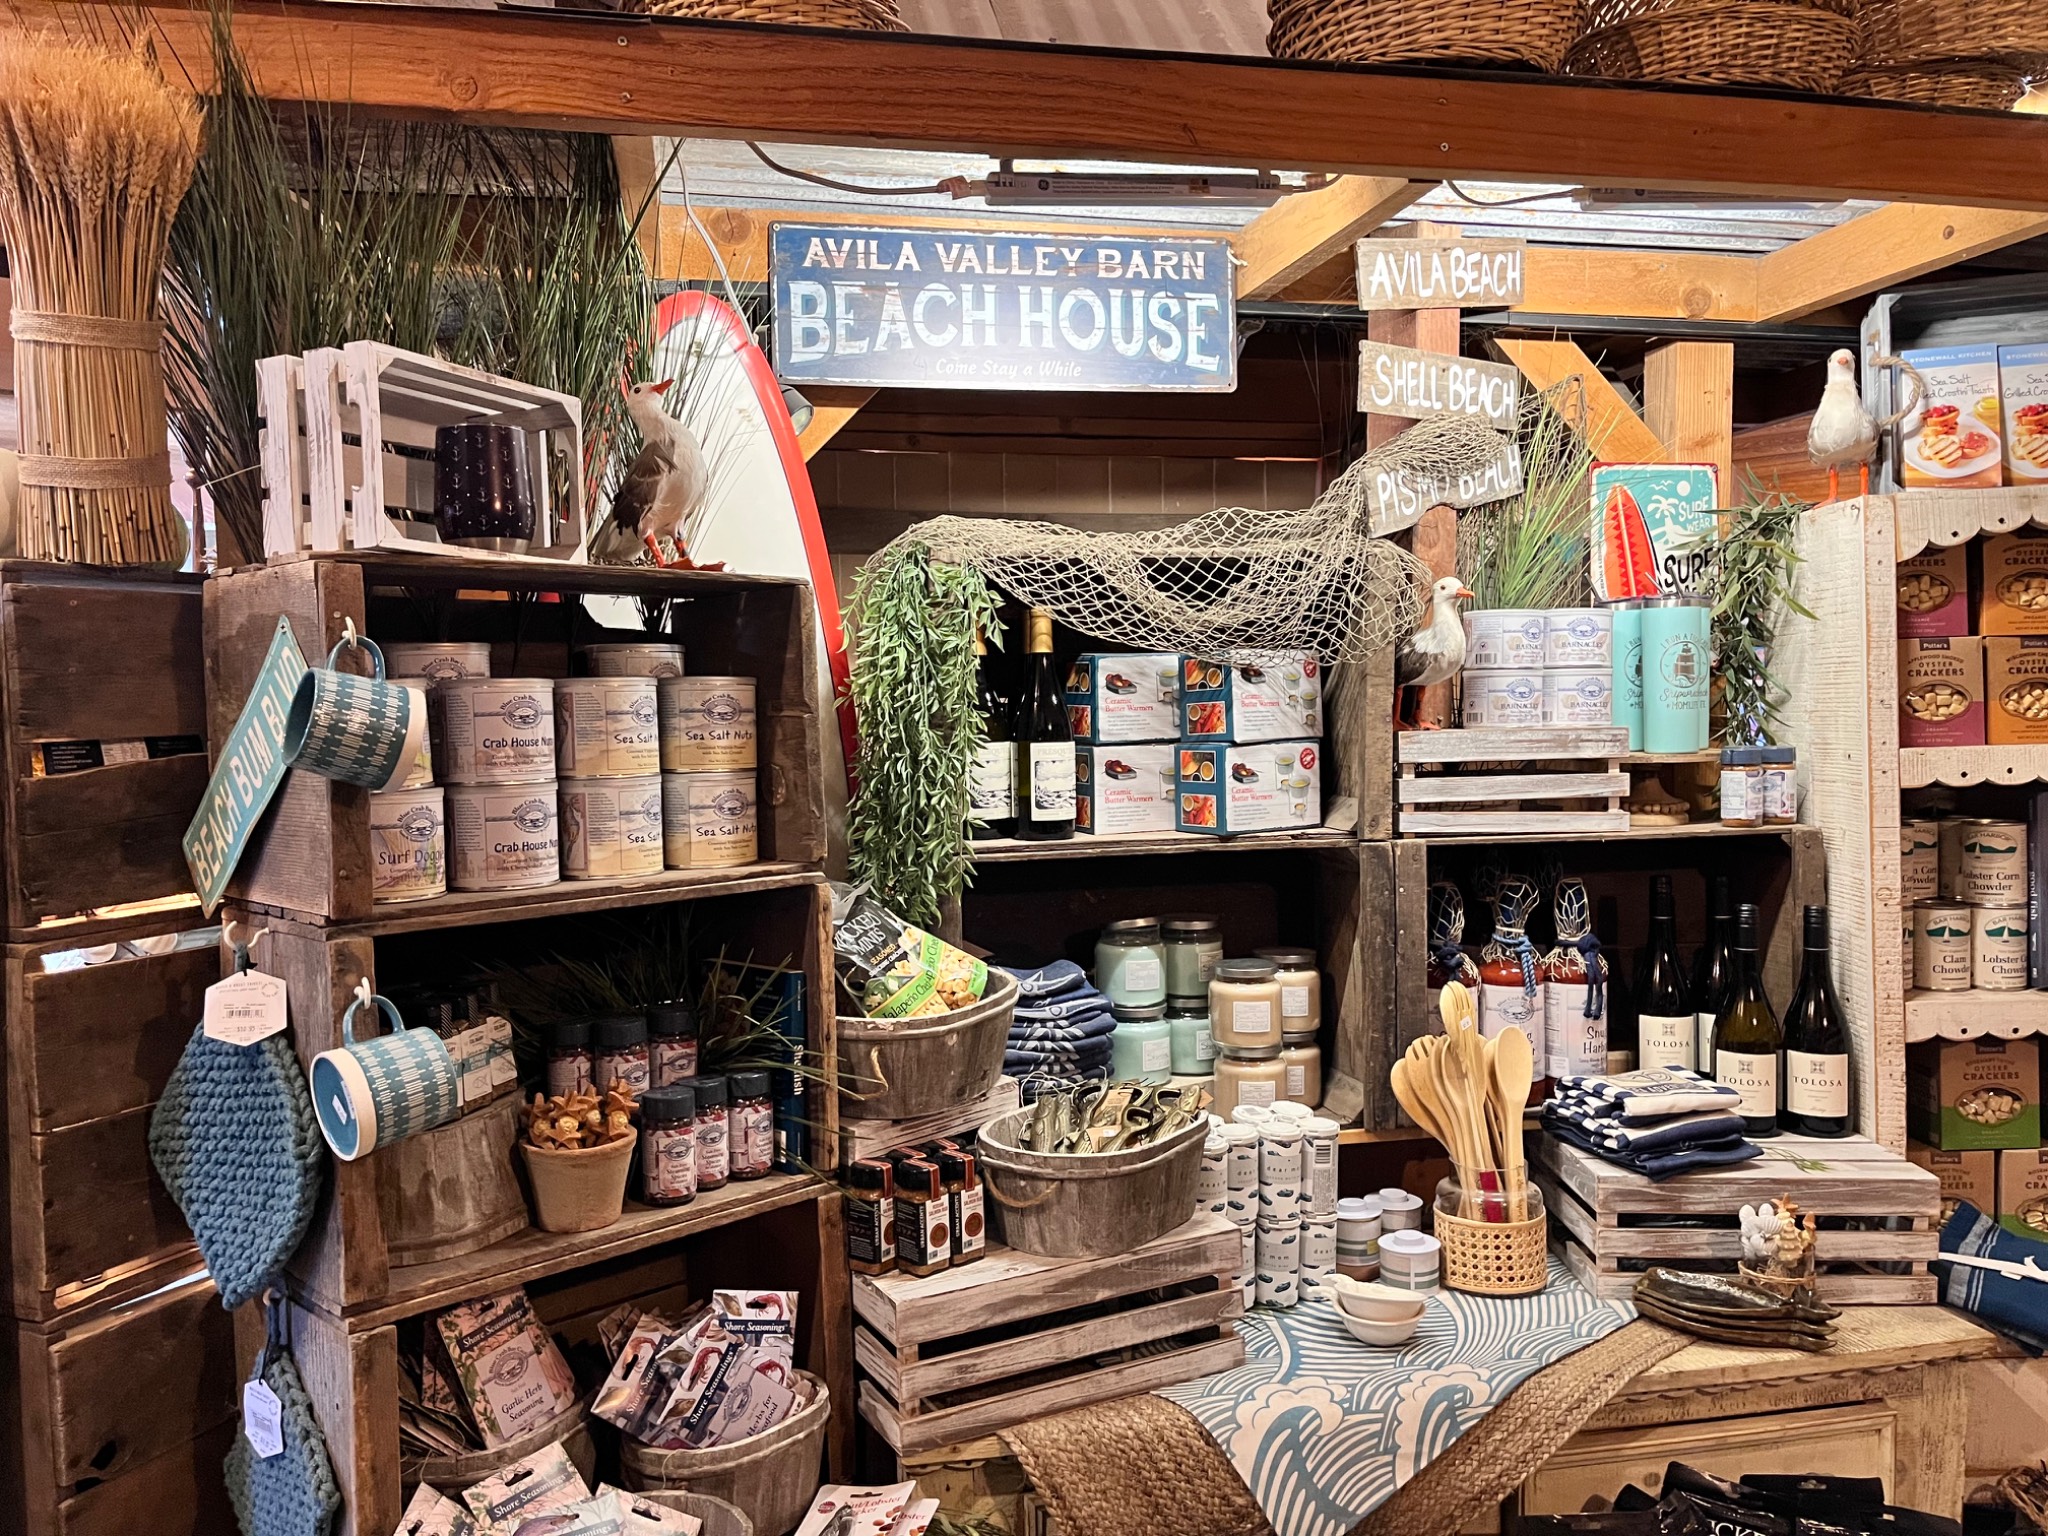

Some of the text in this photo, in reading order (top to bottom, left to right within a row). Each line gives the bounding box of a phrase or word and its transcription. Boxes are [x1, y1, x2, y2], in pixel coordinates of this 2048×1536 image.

[802, 236, 1205, 281] AVILA VALLEY BARN
[1368, 247, 1521, 300] AVILA BEACH
[787, 279, 1223, 373] BEACH HOUSE
[1909, 351, 1992, 364] STONEWALL KITCHEN
[936, 357, 1082, 380] Come Stay a While
[1930, 374, 1971, 386] Sea Salt
[2026, 374, 2043, 385] Sea
[1371, 354, 1516, 418] SHELL BEACH
[1937, 384, 1995, 398] Crostini Toasts
[2033, 387, 2048, 399] Cro
[1679, 496, 1711, 532] SURF WEAR
[1902, 558, 1946, 567] ACKERS
[1562, 640, 1604, 648] BARNACLES
[1907, 668, 1965, 677] CRACKERS
[1104, 697, 1133, 705] Ceramic
[1104, 704, 1154, 713] Butter Warmers
[614, 732, 653, 744] Sea Salt
[685, 729, 753, 741] Sea Salt Nuts
[483, 736, 540, 748] Crab House
[1104, 788, 1132, 797] Ceramic
[192, 776, 242, 893] BEACH
[229, 716, 274, 810] BUM
[1104, 796, 1154, 804] Butter Warmers
[696, 827, 716, 837] Sea
[719, 825, 740, 836] Salt
[627, 833, 645, 844] Sea
[494, 841, 548, 853] Crab House
[378, 850, 410, 866] Surf
[1996, 872, 2020, 880] Corn
[1967, 882, 2013, 892] Chowder
[2030, 900, 2039, 921] fish
[1949, 914, 1969, 923] HARBO
[856, 927, 886, 955] MINIS
[870, 943, 897, 966] SEASONED
[1943, 955, 1967, 963] Clam
[1982, 954, 2019, 964] Lobster
[1991, 964, 2026, 975] Chowd
[1586, 1026, 1606, 1041] Snu
[1583, 1040, 1606, 1055] Harb
[1646, 1038, 1691, 1048] TOLOSA
[1722, 1075, 1771, 1087] TOLOSA
[1793, 1075, 1843, 1087] TOLOSA
[1963, 1071, 2020, 1081] CRACKERS
[1941, 1181, 1974, 1190] CKERS
[2025, 1181, 2048, 1190] CRA
[462, 1309, 524, 1348] Shore Seasonings
[724, 1321, 786, 1332] Shore Seasonings
[689, 1349, 733, 1424] Shore Seasonings
[501, 1383, 543, 1414] Garlic Herb
[626, 1389, 645, 1414] Shore
[761, 1393, 772, 1411] for
[509, 1396, 545, 1422] Seasoning
[494, 1473, 566, 1517] Shore Seasonings
